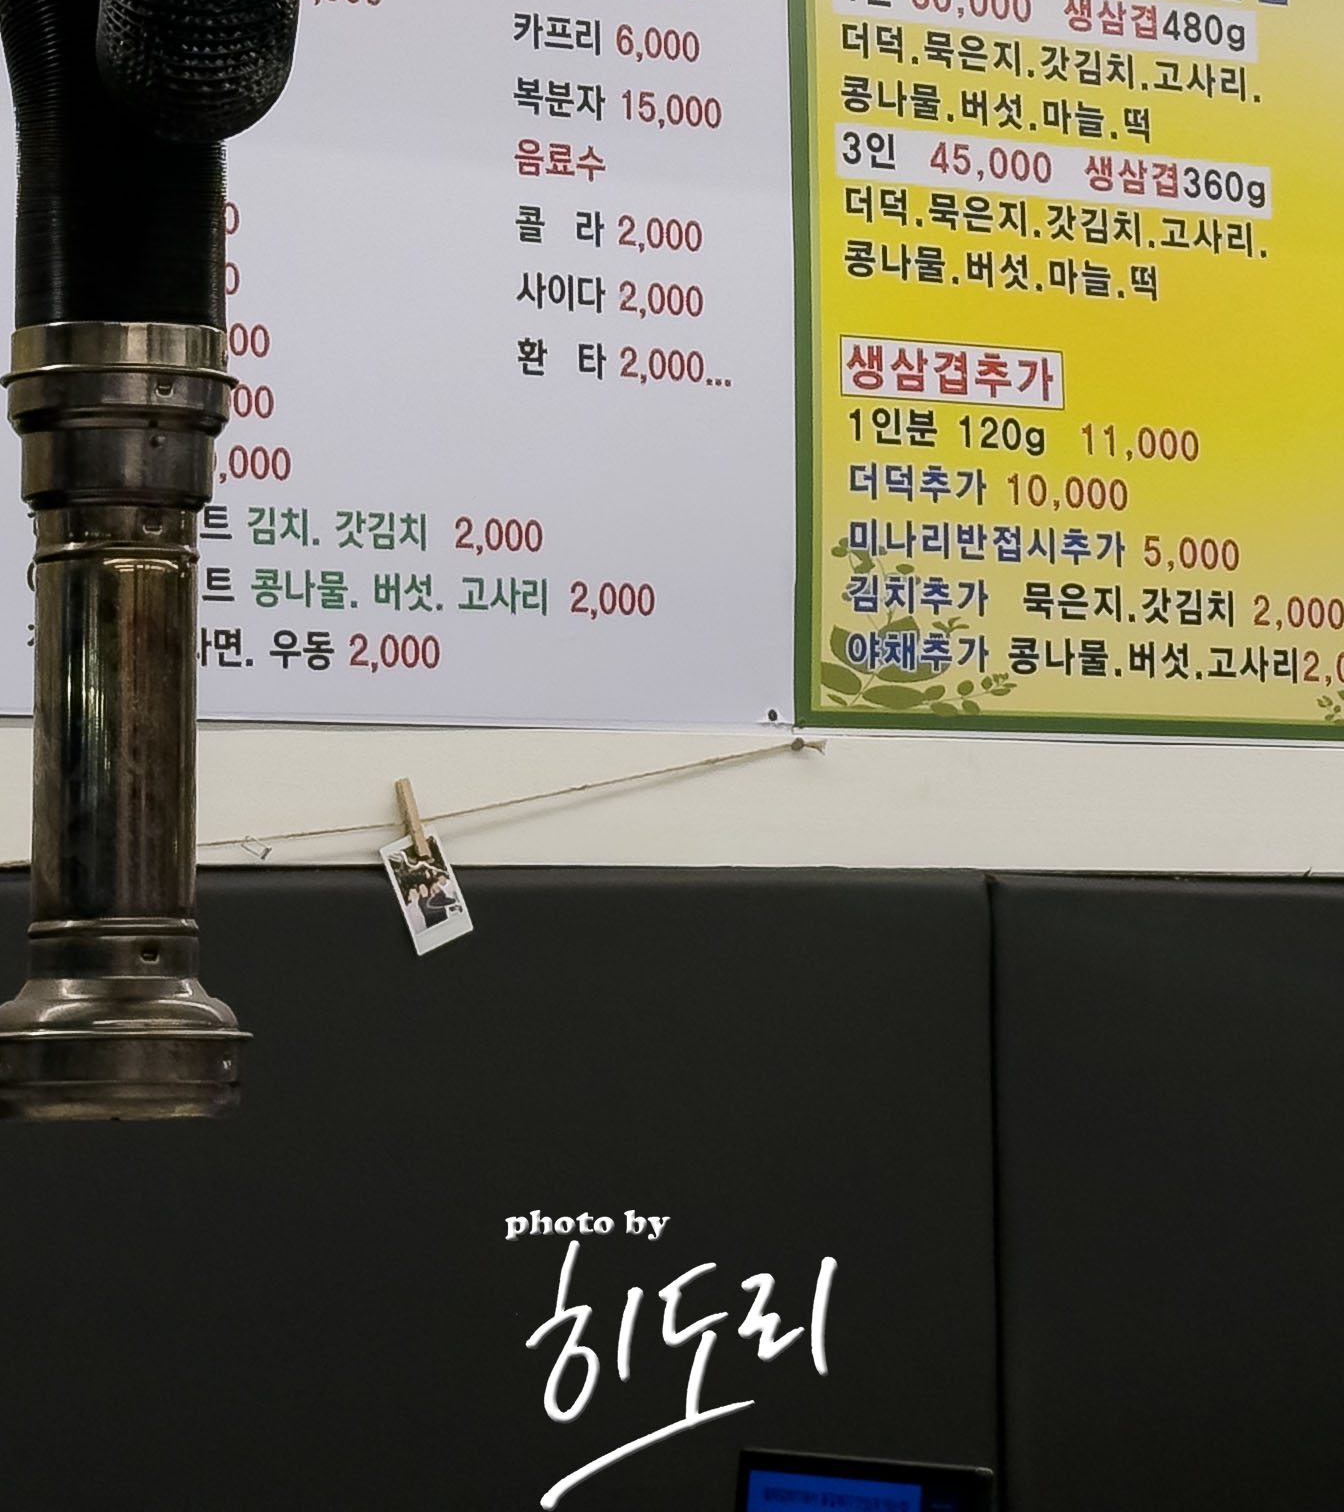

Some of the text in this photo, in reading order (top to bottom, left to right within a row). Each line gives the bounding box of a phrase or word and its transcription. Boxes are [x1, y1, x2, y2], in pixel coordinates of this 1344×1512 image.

[514, 13, 699, 62] 카프리 6,000
[513, 77, 722, 129] 복분자 15,000
[514, 139, 606, 182] 음료수
[842, 131, 896, 171] 3인
[930, 142, 1052, 183] 45,000
[618, 215, 702, 253] 2,000
[516, 272, 703, 319] 사이다 2,000
[846, 343, 1054, 400] 생삼겹추가
[849, 408, 1199, 461] 1인분 120g 11,000
[214, 446, 292, 483] ,000
[850, 462, 1128, 511] 더덕추가 10,000
[247, 507, 320, 547] 김치.
[335, 510, 426, 551] 갓김치
[455, 516, 543, 556] 2,000
[848, 520, 1239, 572] 미나리반접시추가 5,000
[251, 569, 358, 609] 콩나물.
[374, 573, 443, 612] 버섯.
[458, 577, 547, 616] 고사리
[570, 581, 655, 620] 2,000
[846, 575, 988, 616] 김치추가
[1254, 595, 1344, 631] 2,000
[269, 630, 335, 670] 우동
[349, 633, 440, 673] 2,000
[847, 632, 989, 673] 야채추가
